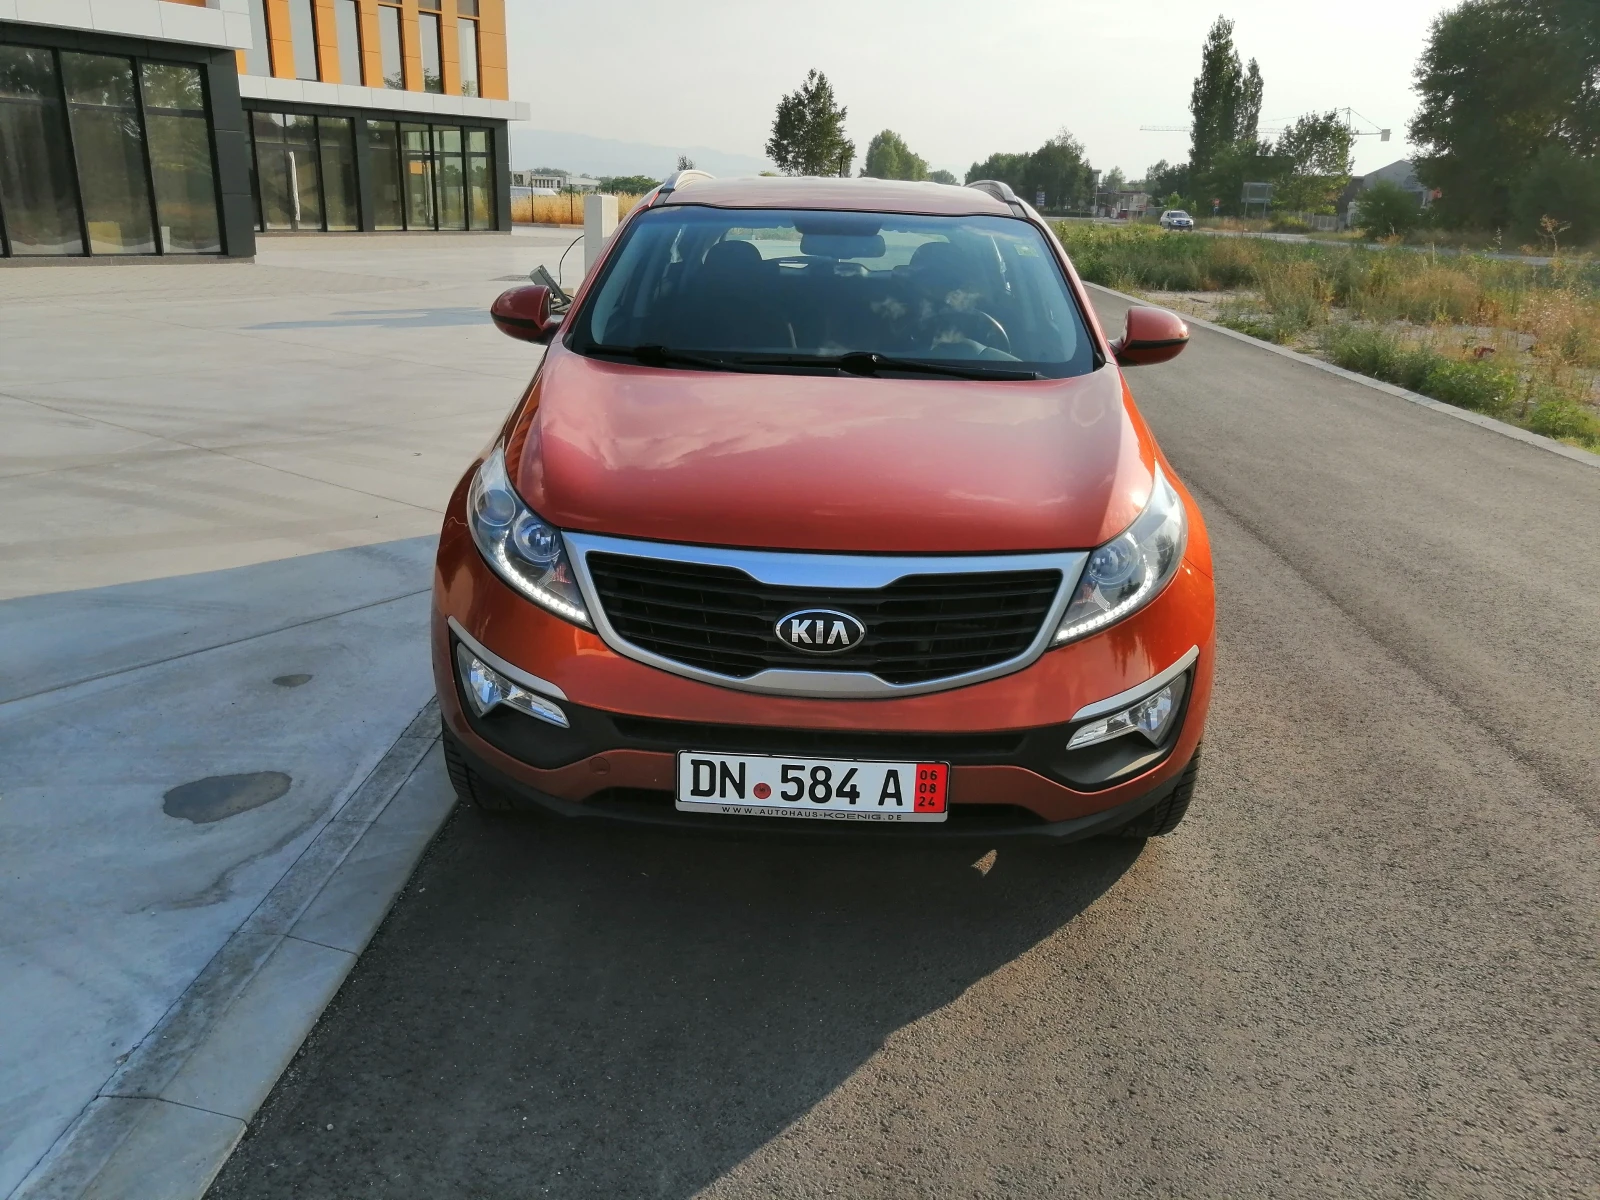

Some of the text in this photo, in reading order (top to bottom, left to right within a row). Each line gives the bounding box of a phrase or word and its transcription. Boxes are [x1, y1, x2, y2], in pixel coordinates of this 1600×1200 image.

[791, 619, 850, 644] KIA
[919, 769, 938, 781] 06
[690, 759, 904, 806] DN 584 A
[919, 782, 937, 794] 08
[918, 796, 936, 807] 24
